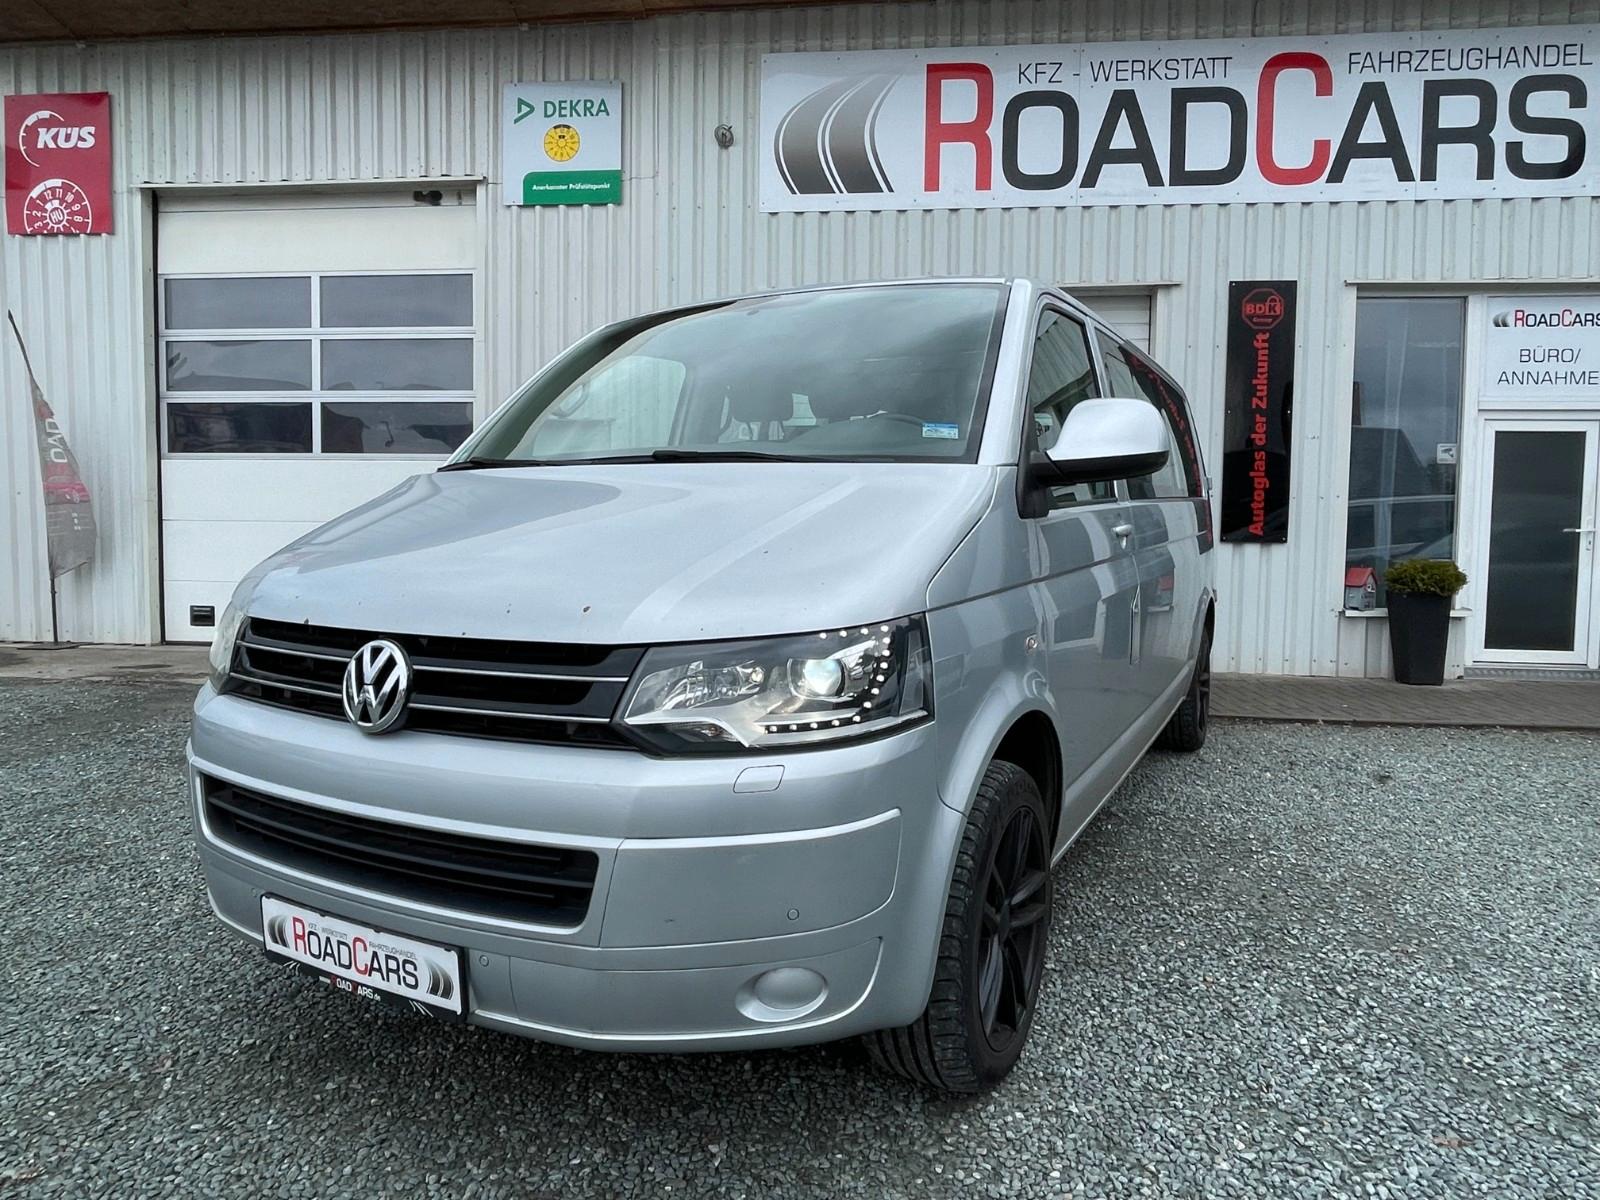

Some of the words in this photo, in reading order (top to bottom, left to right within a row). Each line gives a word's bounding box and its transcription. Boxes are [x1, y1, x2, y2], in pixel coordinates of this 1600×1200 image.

[1018, 62, 1063, 84] KFZ
[1090, 56, 1233, 82] WERKSTATT
[1348, 43, 1594, 75] FAHRZEUGHANDEL
[543, 97, 610, 118] DEKRA
[923, 51, 1588, 193] ROADCARS
[36, 126, 96, 149] KÜS
[43, 190, 53, 200] 12
[56, 188, 63, 198] 11
[64, 191, 74, 203] 10
[34, 221, 43, 229] 3
[50, 208, 64, 224] HU
[1519, 345, 1581, 364] BÜRO/
[1251, 331, 1270, 409] Zukunft
[1497, 370, 1600, 385] ANNAHME
[1251, 413, 1267, 446] der
[1248, 450, 1270, 536] Autoglas
[292, 916, 420, 990] ROADCARS
